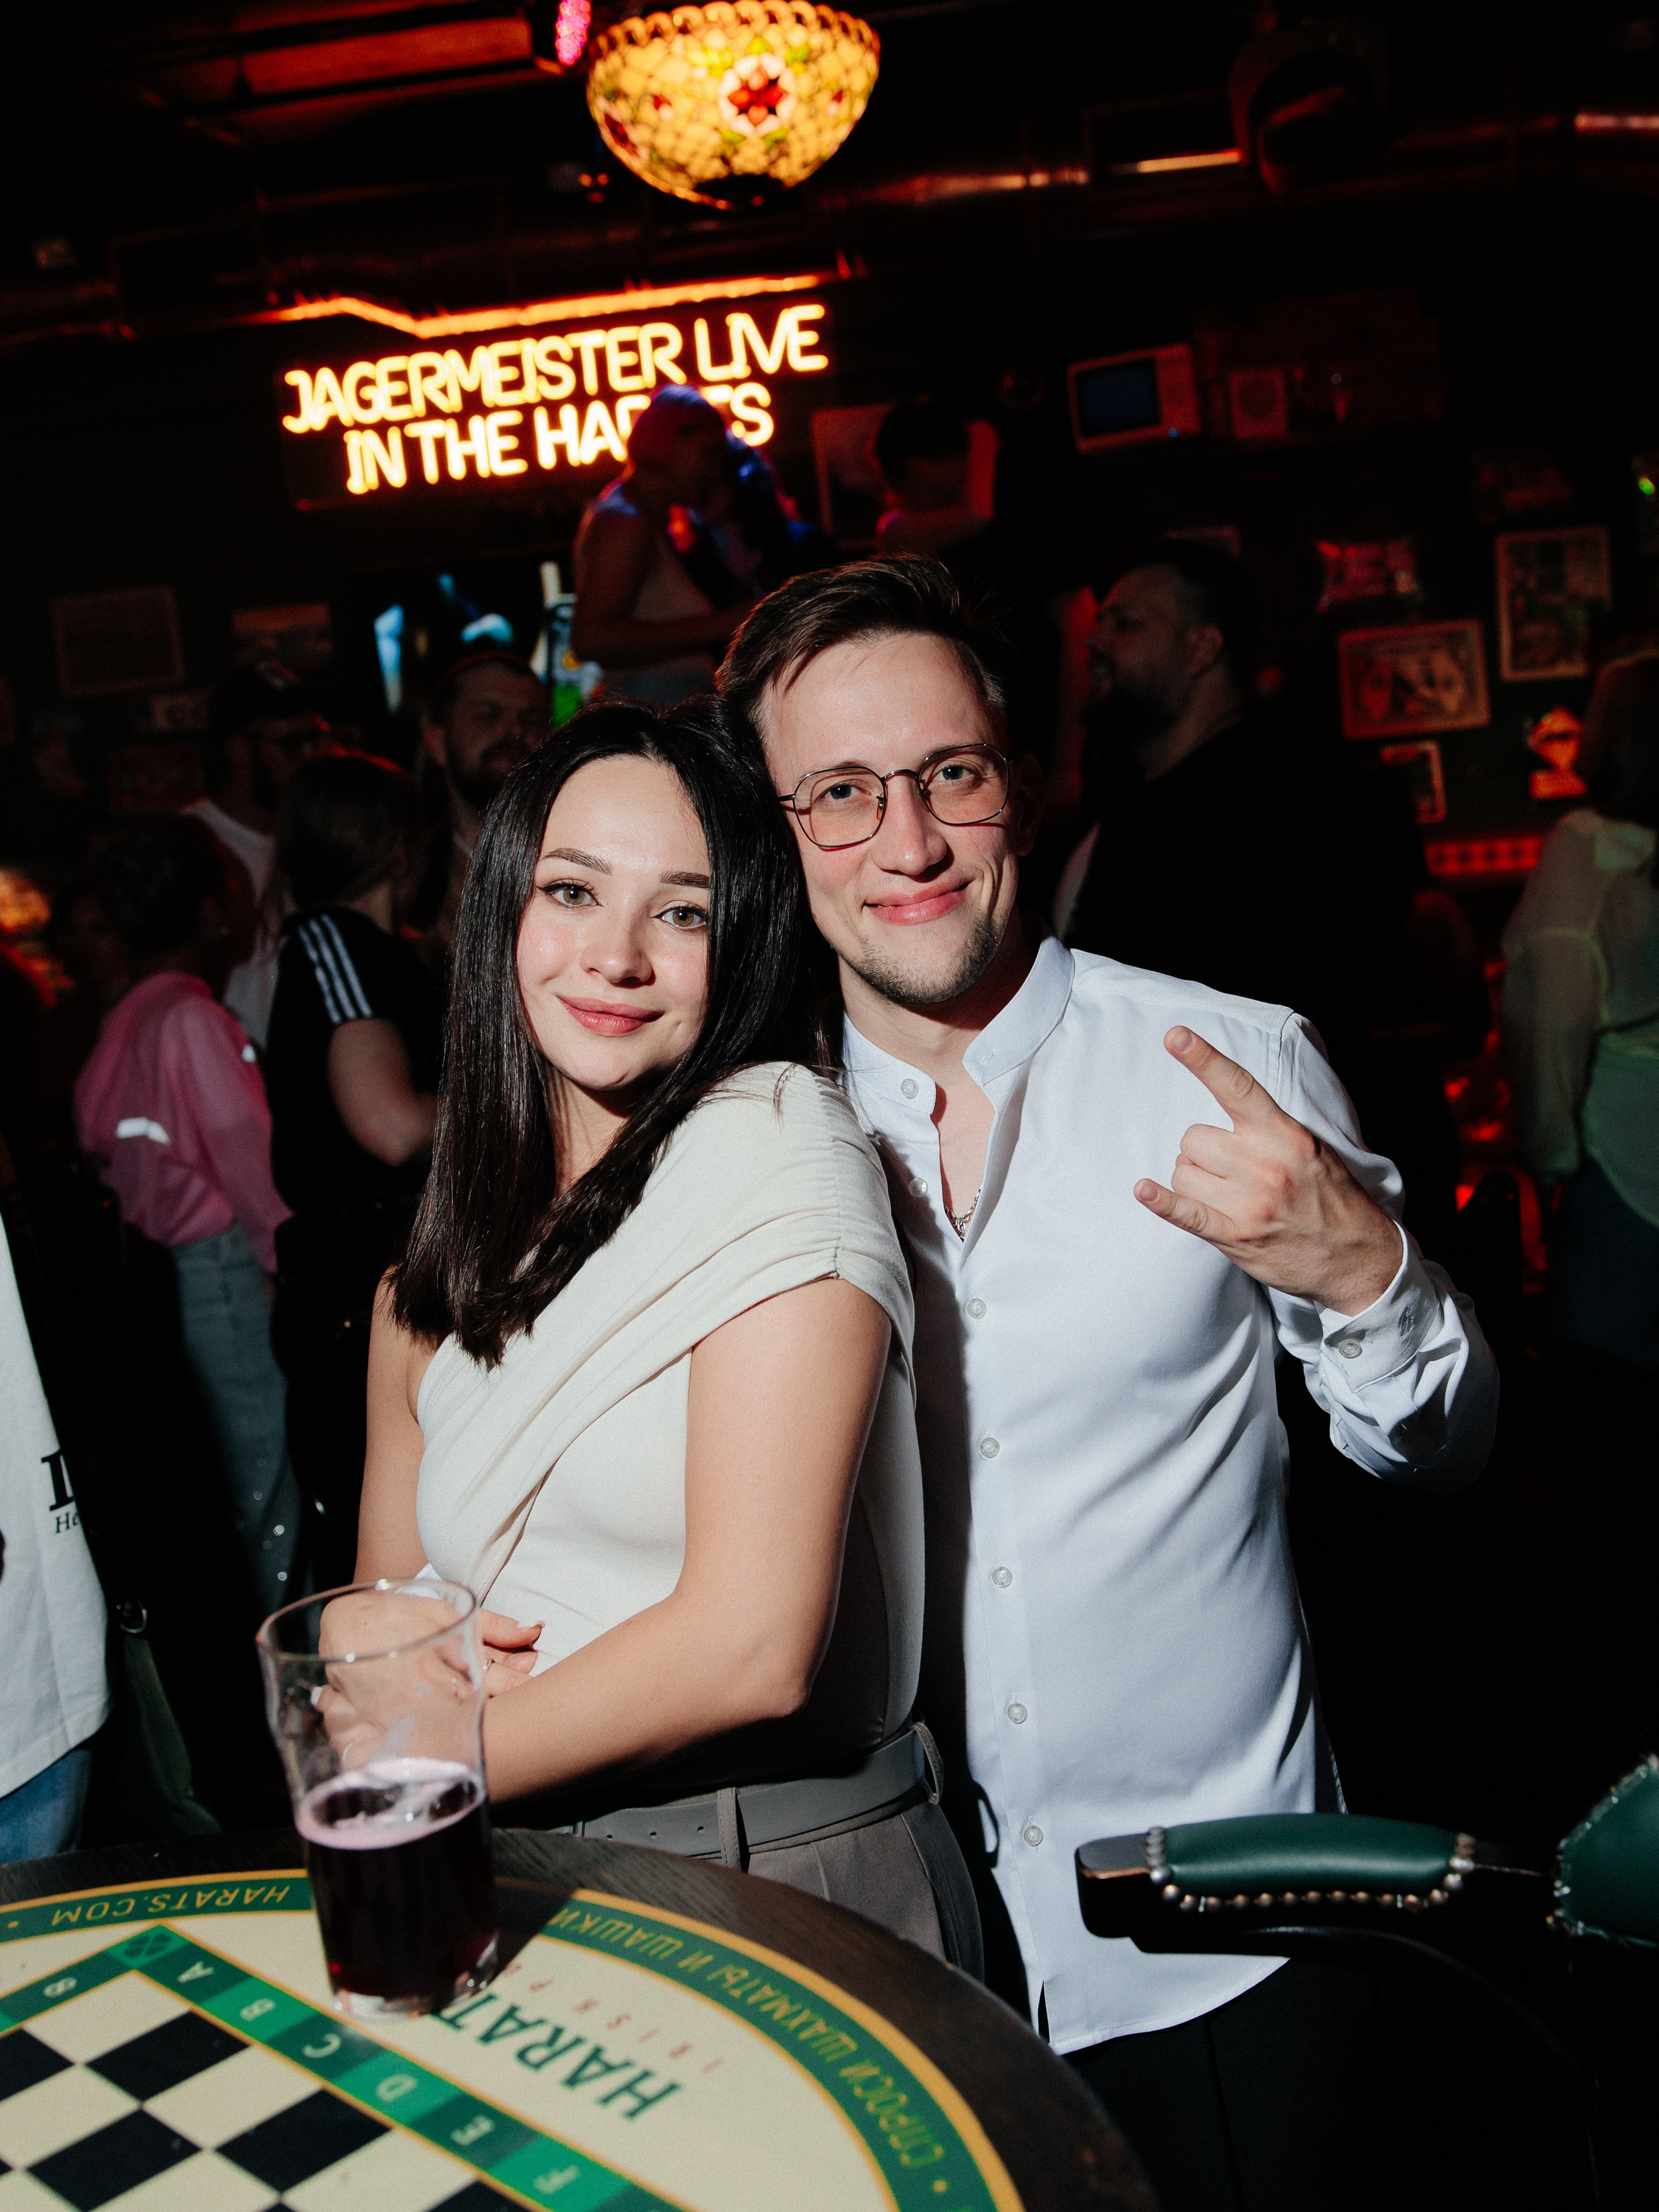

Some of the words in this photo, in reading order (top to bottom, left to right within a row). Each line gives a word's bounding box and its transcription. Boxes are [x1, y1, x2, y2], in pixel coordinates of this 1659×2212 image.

[283, 321, 687, 434] JAGERMEISTER
[694, 303, 830, 381] LIVE
[344, 425, 408, 495] IN
[404, 410, 528, 485] THE
[533, 382, 775, 471] HAS
[51, 1885, 290, 1927] HARATS.COM
[549, 1907, 684, 1961] ШАШКИ
[678, 1950, 713, 1974] И
[707, 1964, 859, 2063] ШАХМАТЫ
[177, 1960, 215, 1984] A
[240, 1997, 276, 2021] B
[302, 2032, 342, 2060] C
[376, 2073, 418, 2102] D
[450, 2114, 495, 2147] E
[533, 2164, 580, 2195] F
